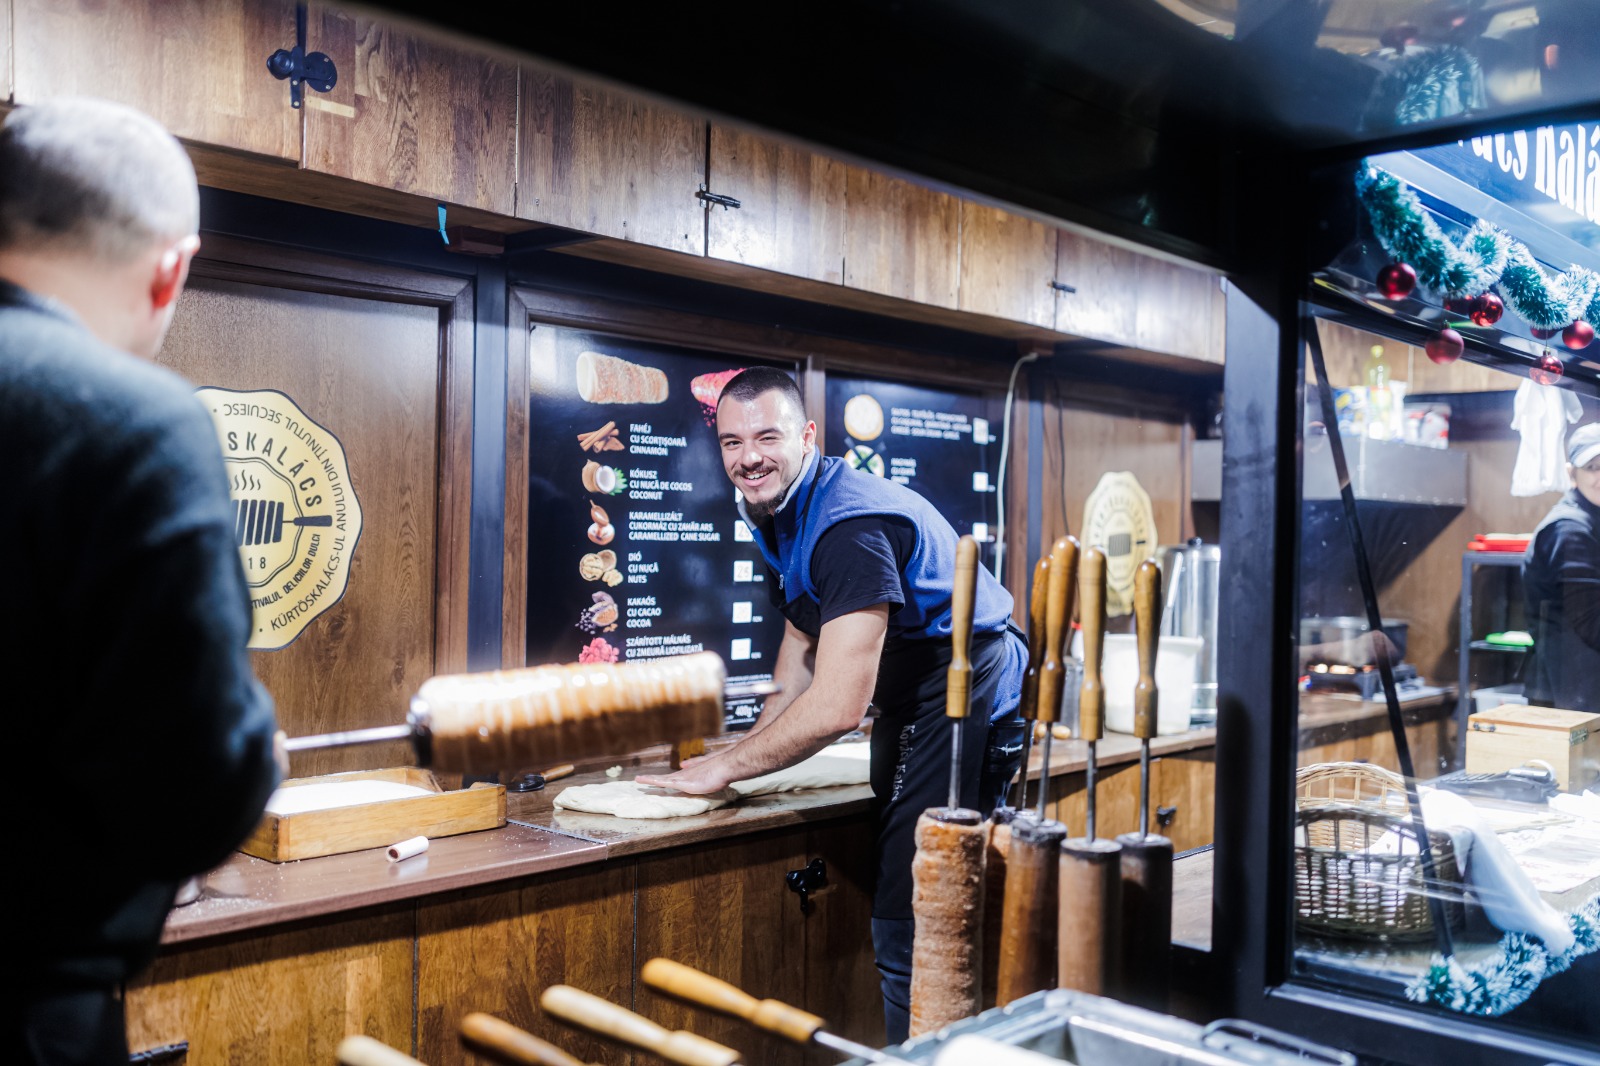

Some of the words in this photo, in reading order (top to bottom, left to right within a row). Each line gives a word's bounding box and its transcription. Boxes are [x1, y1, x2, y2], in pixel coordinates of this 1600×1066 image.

[223, 403, 283, 424] SECUIESC
[630, 424, 652, 434] FAHÉJ
[630, 434, 640, 443] CU
[629, 445, 668, 456] CINNAMON
[227, 431, 322, 507] SKALÁCS
[321, 458, 338, 482] DIN
[629, 468, 657, 479] KÓKUSZ
[629, 480, 640, 489] CU
[640, 480, 659, 490] NUCĂ
[660, 481, 670, 490] DE
[670, 482, 693, 491] COCOS
[629, 490, 663, 500] COCONUT
[332, 482, 347, 531] ANULUI
[629, 511, 683, 521] KARAMELLIZÁLT
[629, 521, 667, 531] CUKORMÁZ
[668, 522, 678, 531] CU
[700, 523, 713, 532] ARS
[629, 531, 679, 541] CARAMELLIZED
[681, 532, 698, 541] CANE
[698, 532, 720, 541] SUGAR
[628, 551, 642, 562] DIÓ
[252, 591, 283, 610] TIVALUL
[308, 534, 321, 557] DULCI
[628, 563, 638, 573] CU
[638, 562, 659, 573] NUCĂ
[628, 574, 647, 583] NUTS
[627, 596, 656, 606] KAKAÓS
[626, 608, 637, 617] CU
[638, 607, 662, 617] CACAO
[626, 618, 652, 628] COCOA
[663, 634, 691, 645] MÁLNÁS
[625, 648, 636, 658] CU
